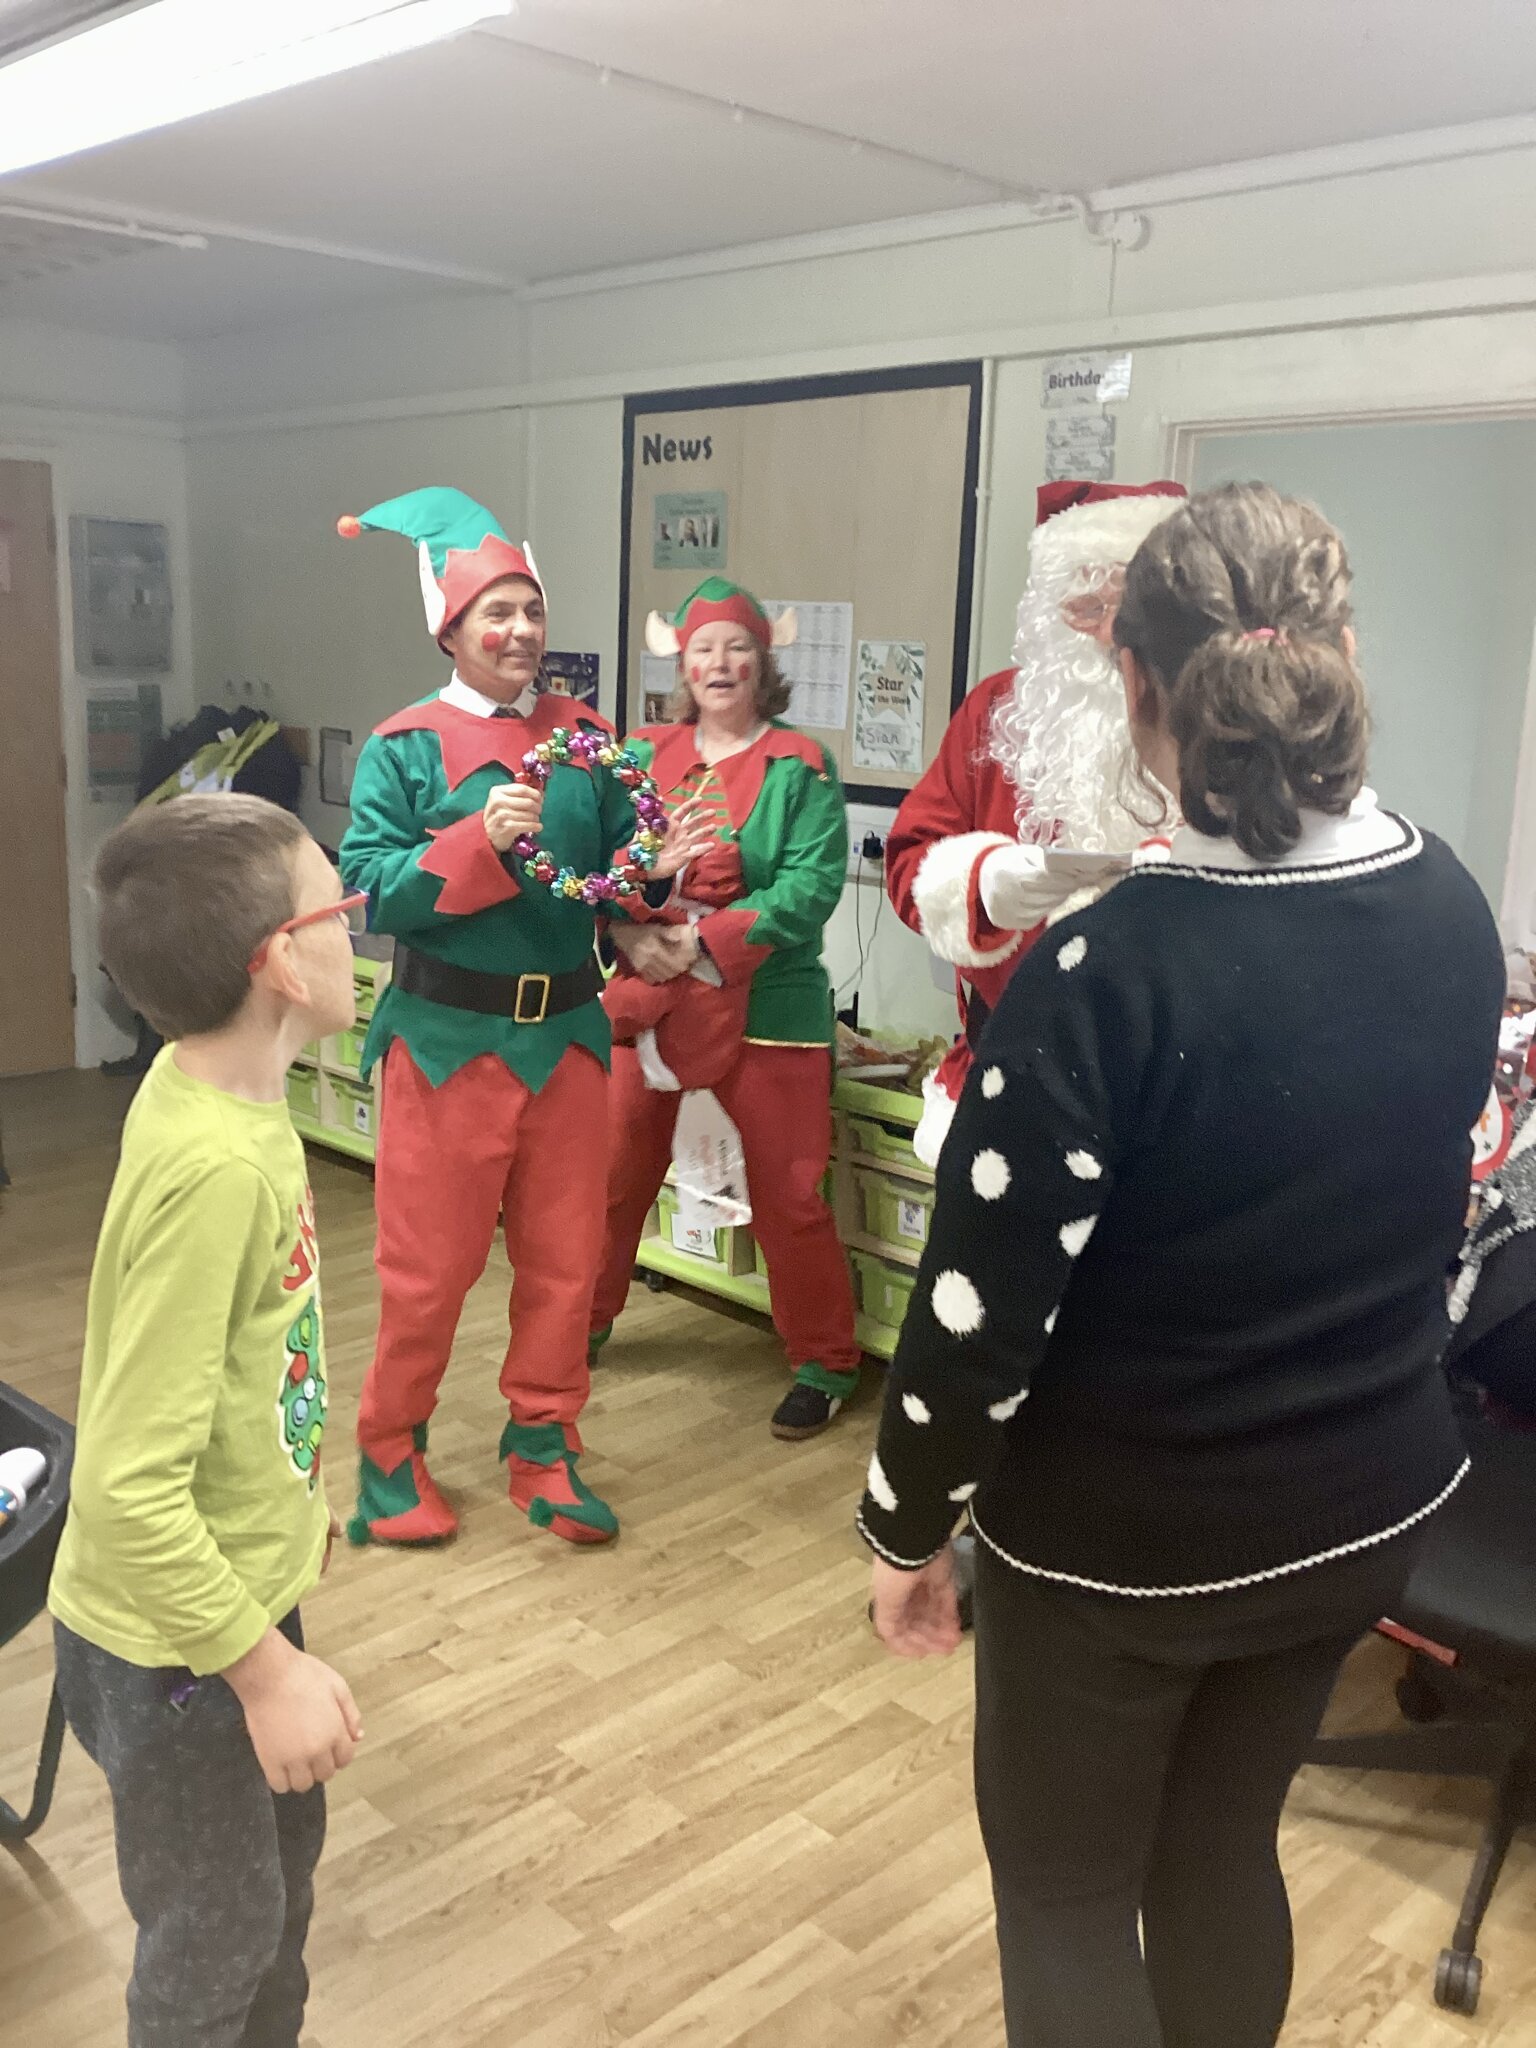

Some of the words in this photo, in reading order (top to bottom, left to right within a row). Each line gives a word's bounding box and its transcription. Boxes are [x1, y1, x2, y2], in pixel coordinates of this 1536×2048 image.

[1049, 369, 1105, 389] Birthda
[642, 433, 713, 466] News
[877, 676, 903, 691] Star
[865, 726, 901, 745] Sian
